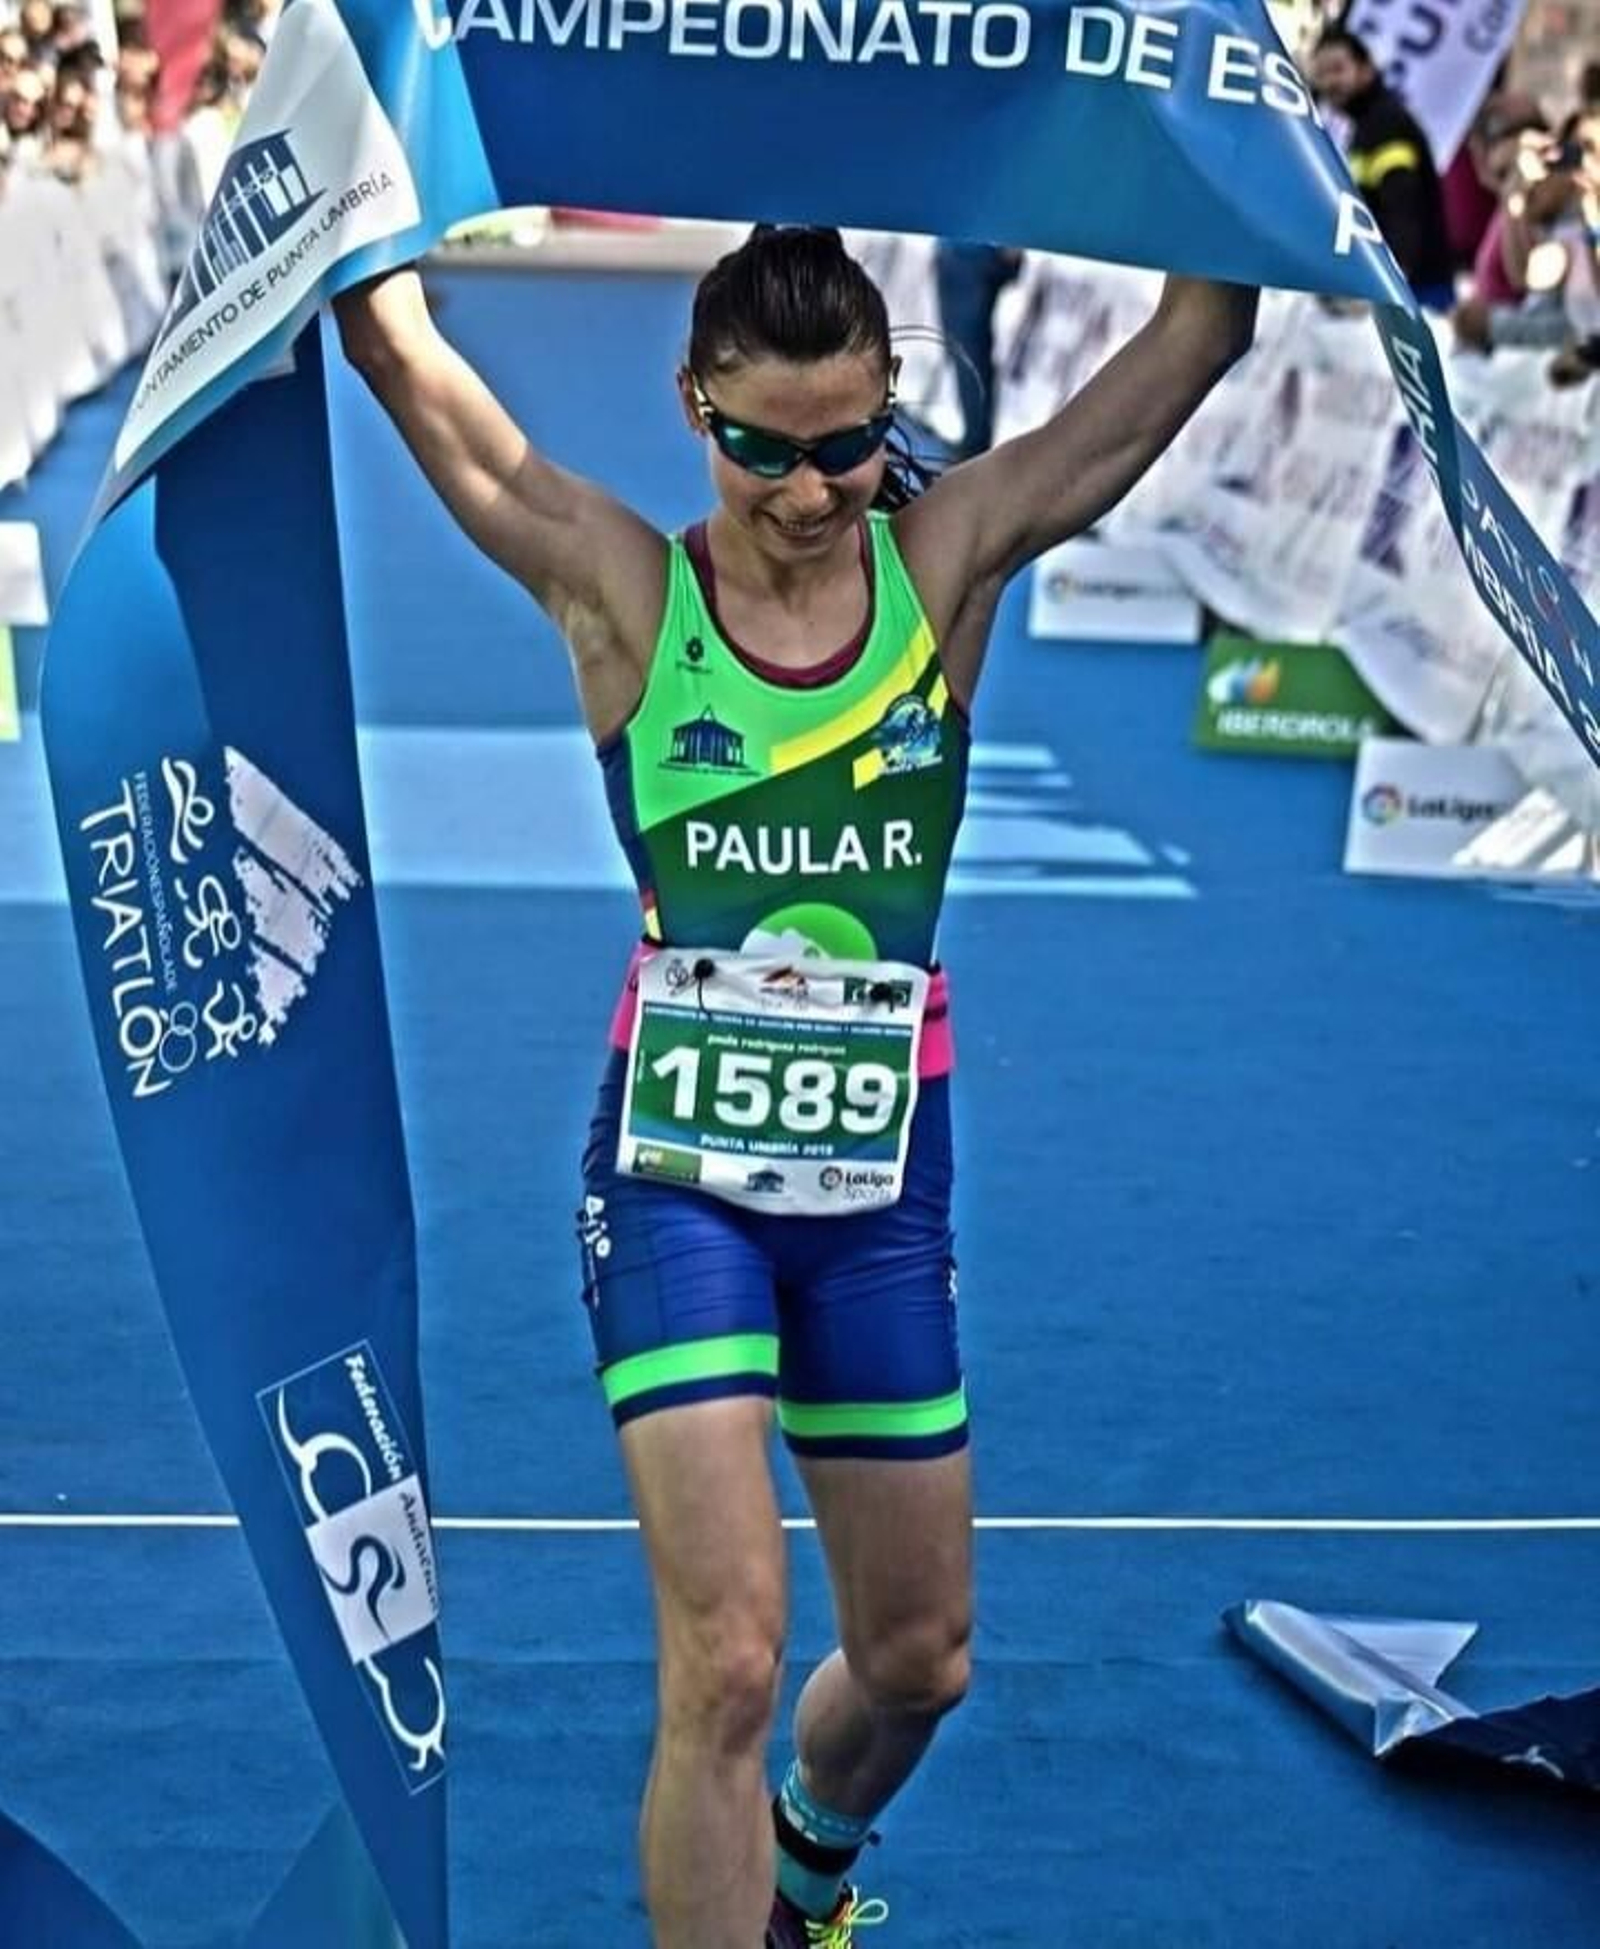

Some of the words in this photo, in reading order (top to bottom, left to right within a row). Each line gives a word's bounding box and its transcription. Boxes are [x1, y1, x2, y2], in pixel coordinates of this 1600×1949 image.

[1065, 6, 1179, 90] DE
[1207, 34, 1325, 130] ES
[238, 283, 267, 316] DE
[267, 229, 320, 287] PUNTA
[320, 171, 394, 232] UMBRÍA
[685, 820, 869, 875] PAULA
[883, 819, 922, 868] R.
[80, 778, 172, 1098] TRIATLÓN
[652, 1045, 899, 1134] 1589
[700, 1133, 745, 1151] PUNTA
[344, 1353, 401, 1482] Federación
